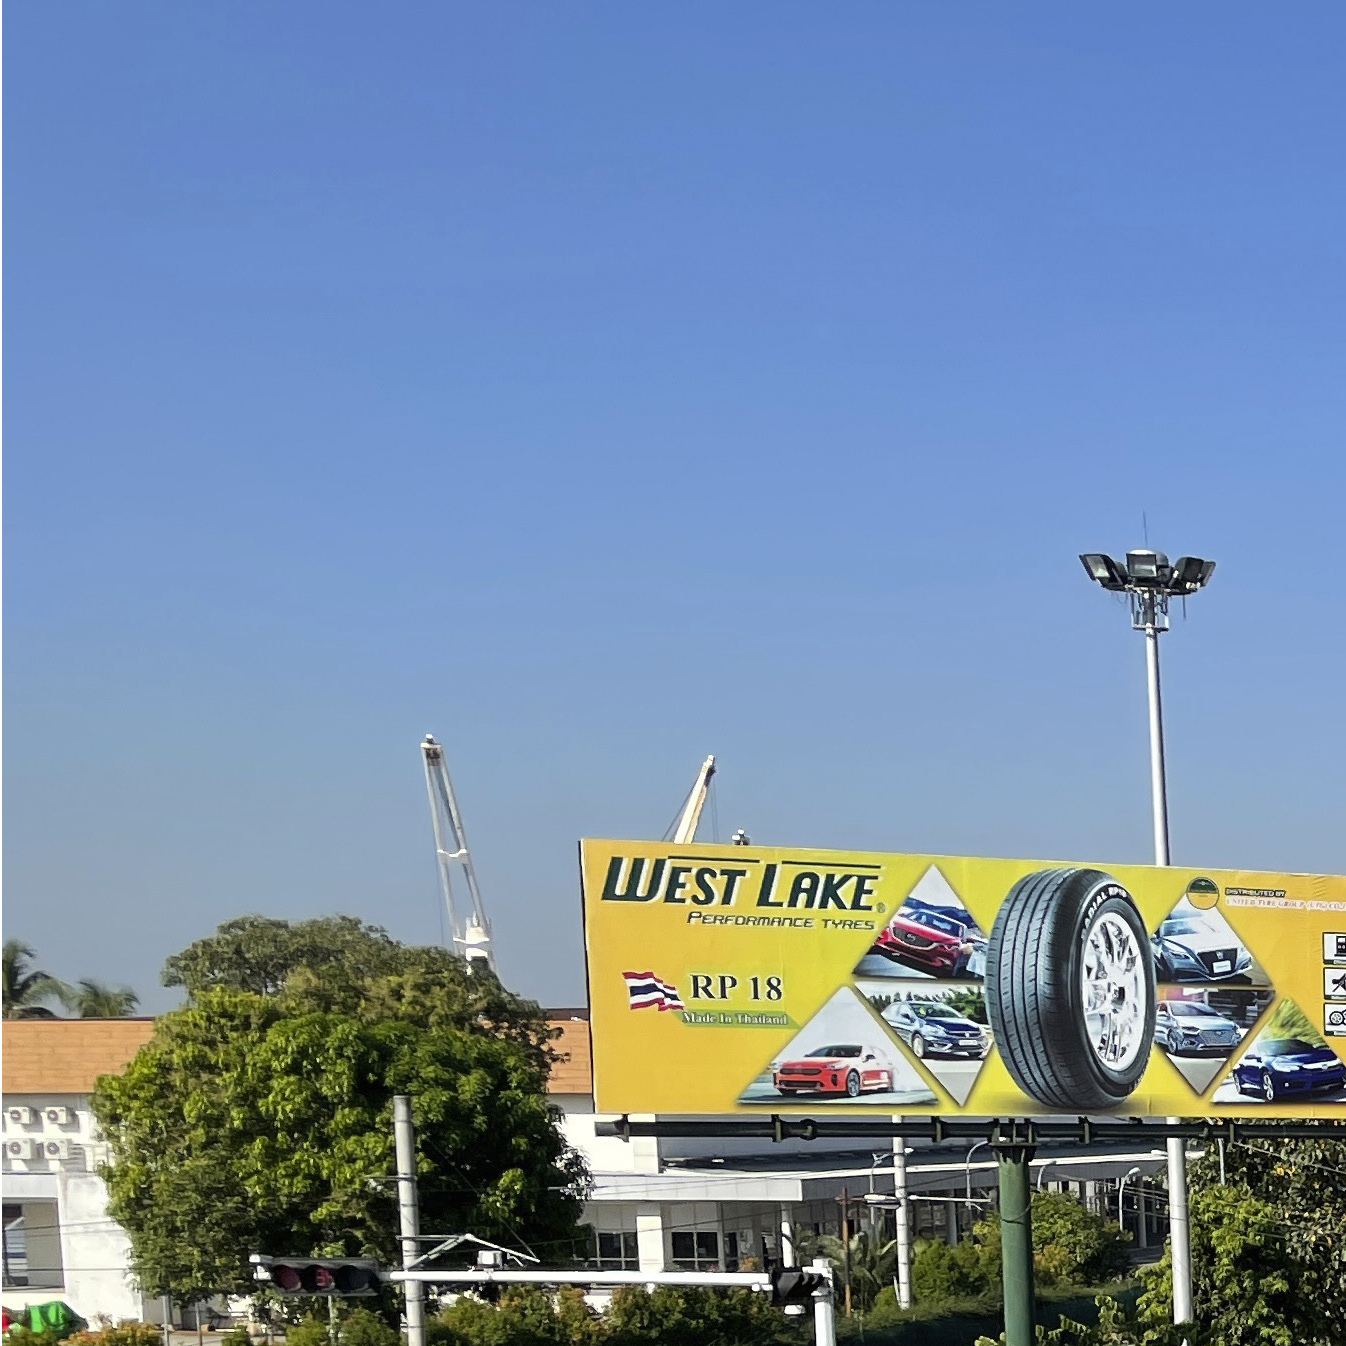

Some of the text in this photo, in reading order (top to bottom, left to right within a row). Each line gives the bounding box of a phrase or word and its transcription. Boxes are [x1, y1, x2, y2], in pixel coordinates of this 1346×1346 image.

[601, 856, 879, 911] WEST LAKE
[687, 911, 875, 929] PERFORMANCE TYRES
[690, 974, 783, 1001] RP 18
[681, 1012, 787, 1025] Made In Thailand
